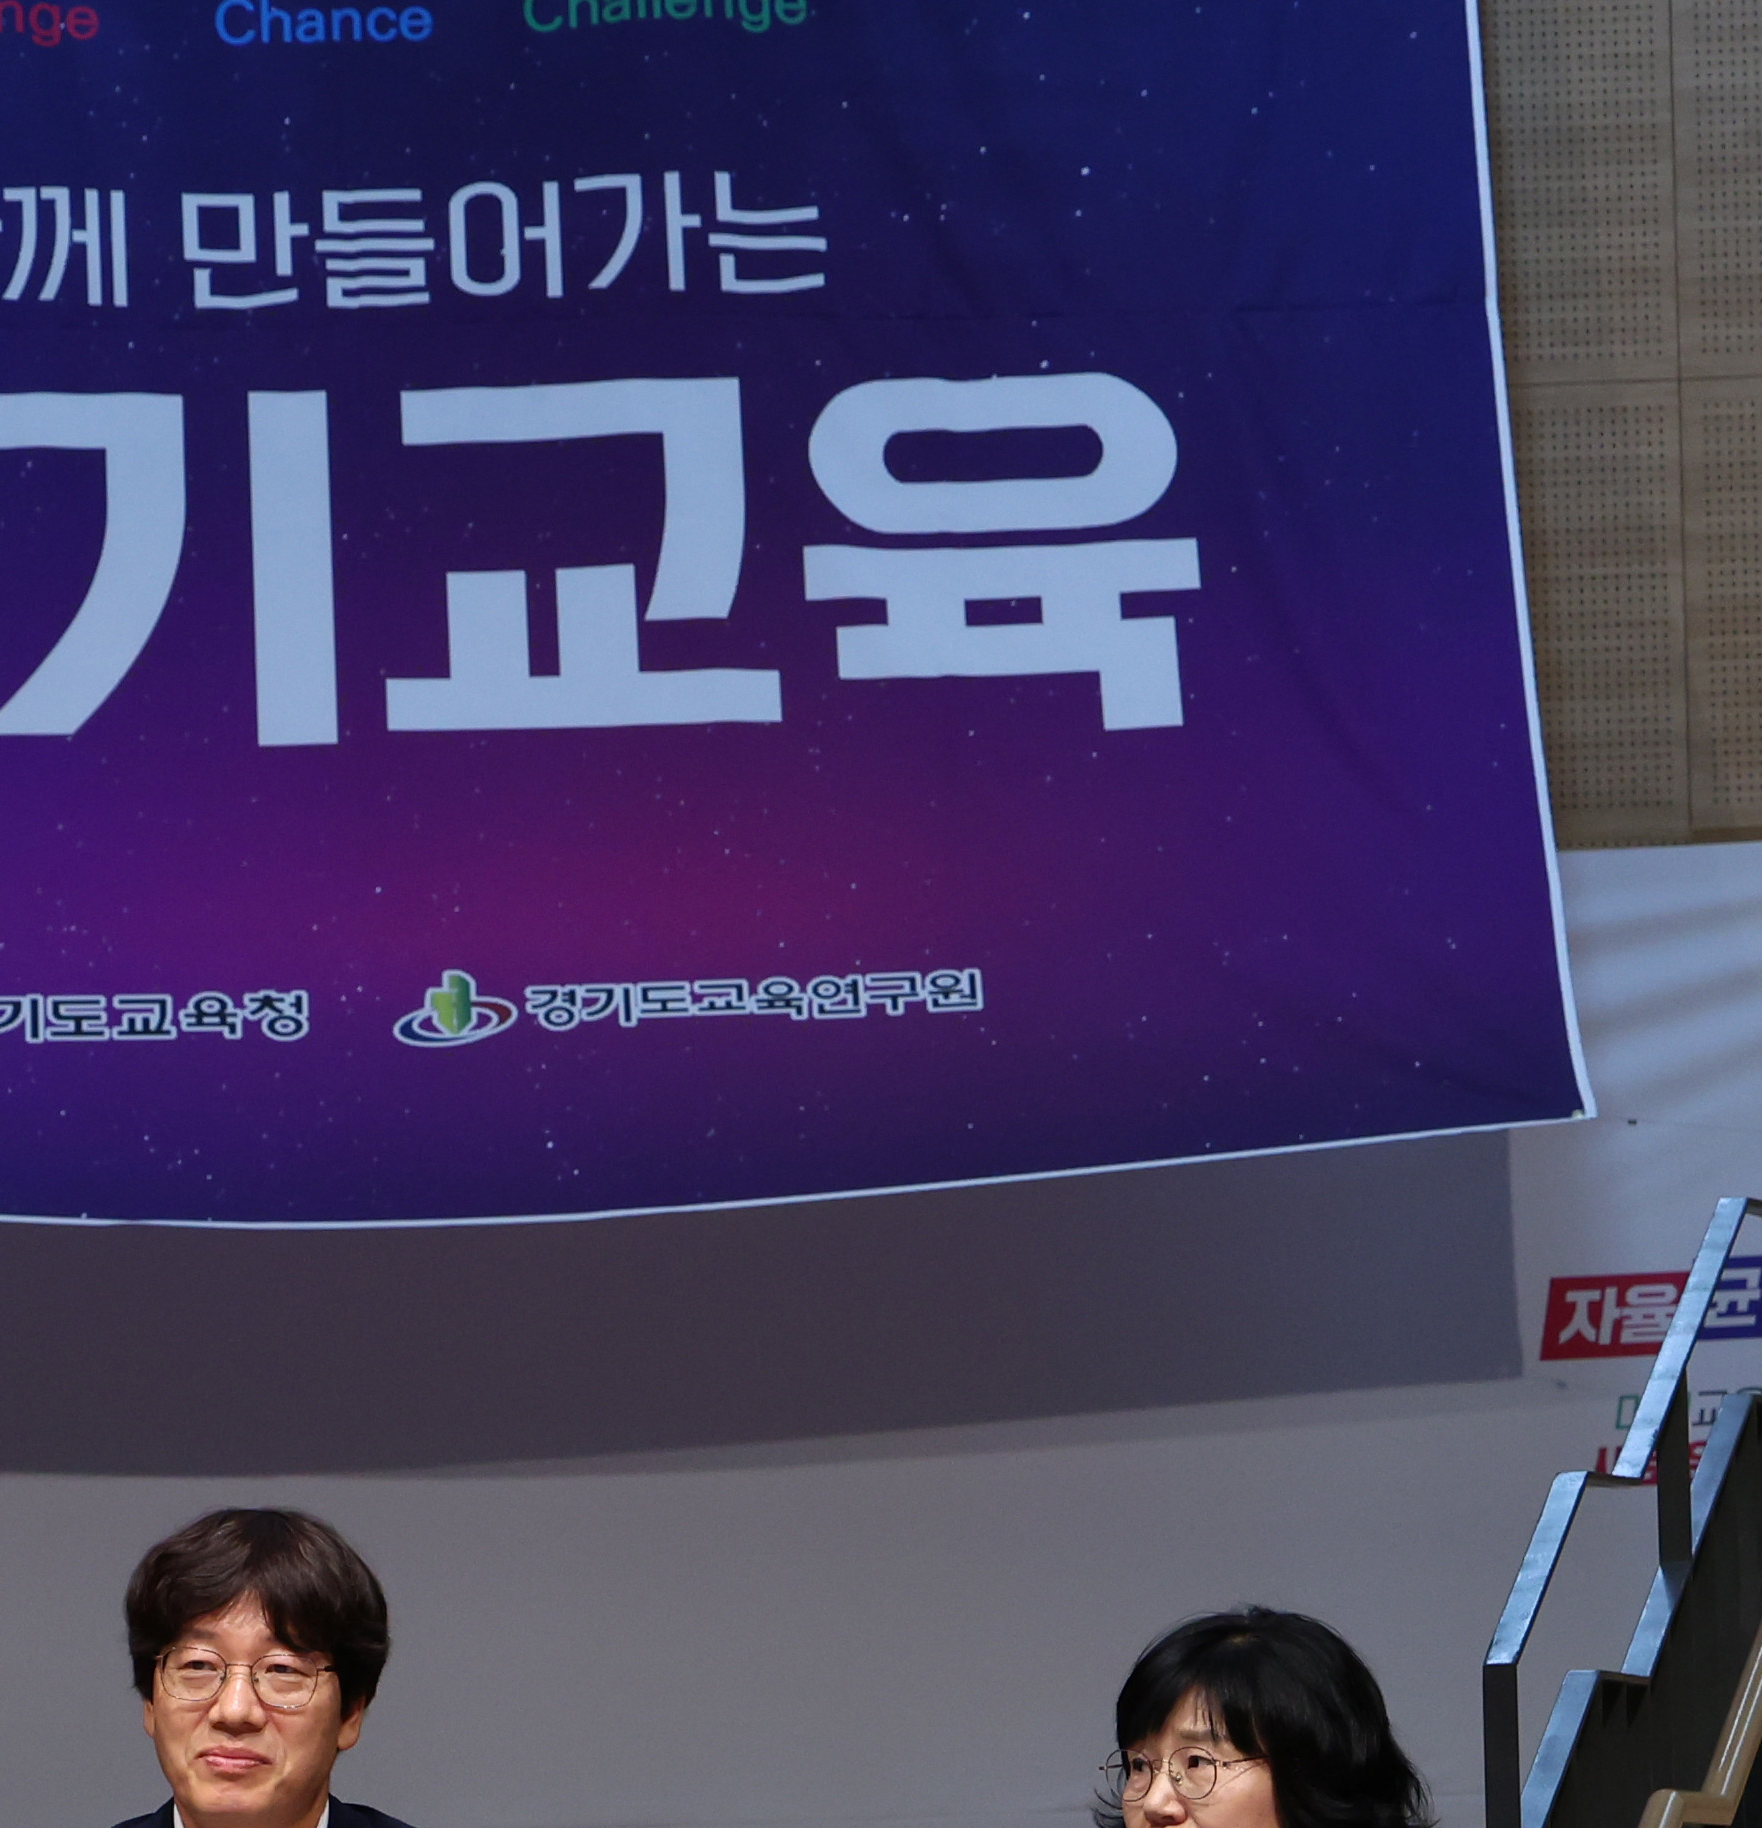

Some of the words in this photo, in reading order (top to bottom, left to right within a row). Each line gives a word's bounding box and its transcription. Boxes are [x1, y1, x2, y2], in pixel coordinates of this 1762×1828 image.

[214, 0, 434, 45] Chance
[182, 170, 827, 309] 만들어가는
[525, 967, 984, 1031] 경기도교육연구원
[1558, 1283, 1679, 1345] 자율
